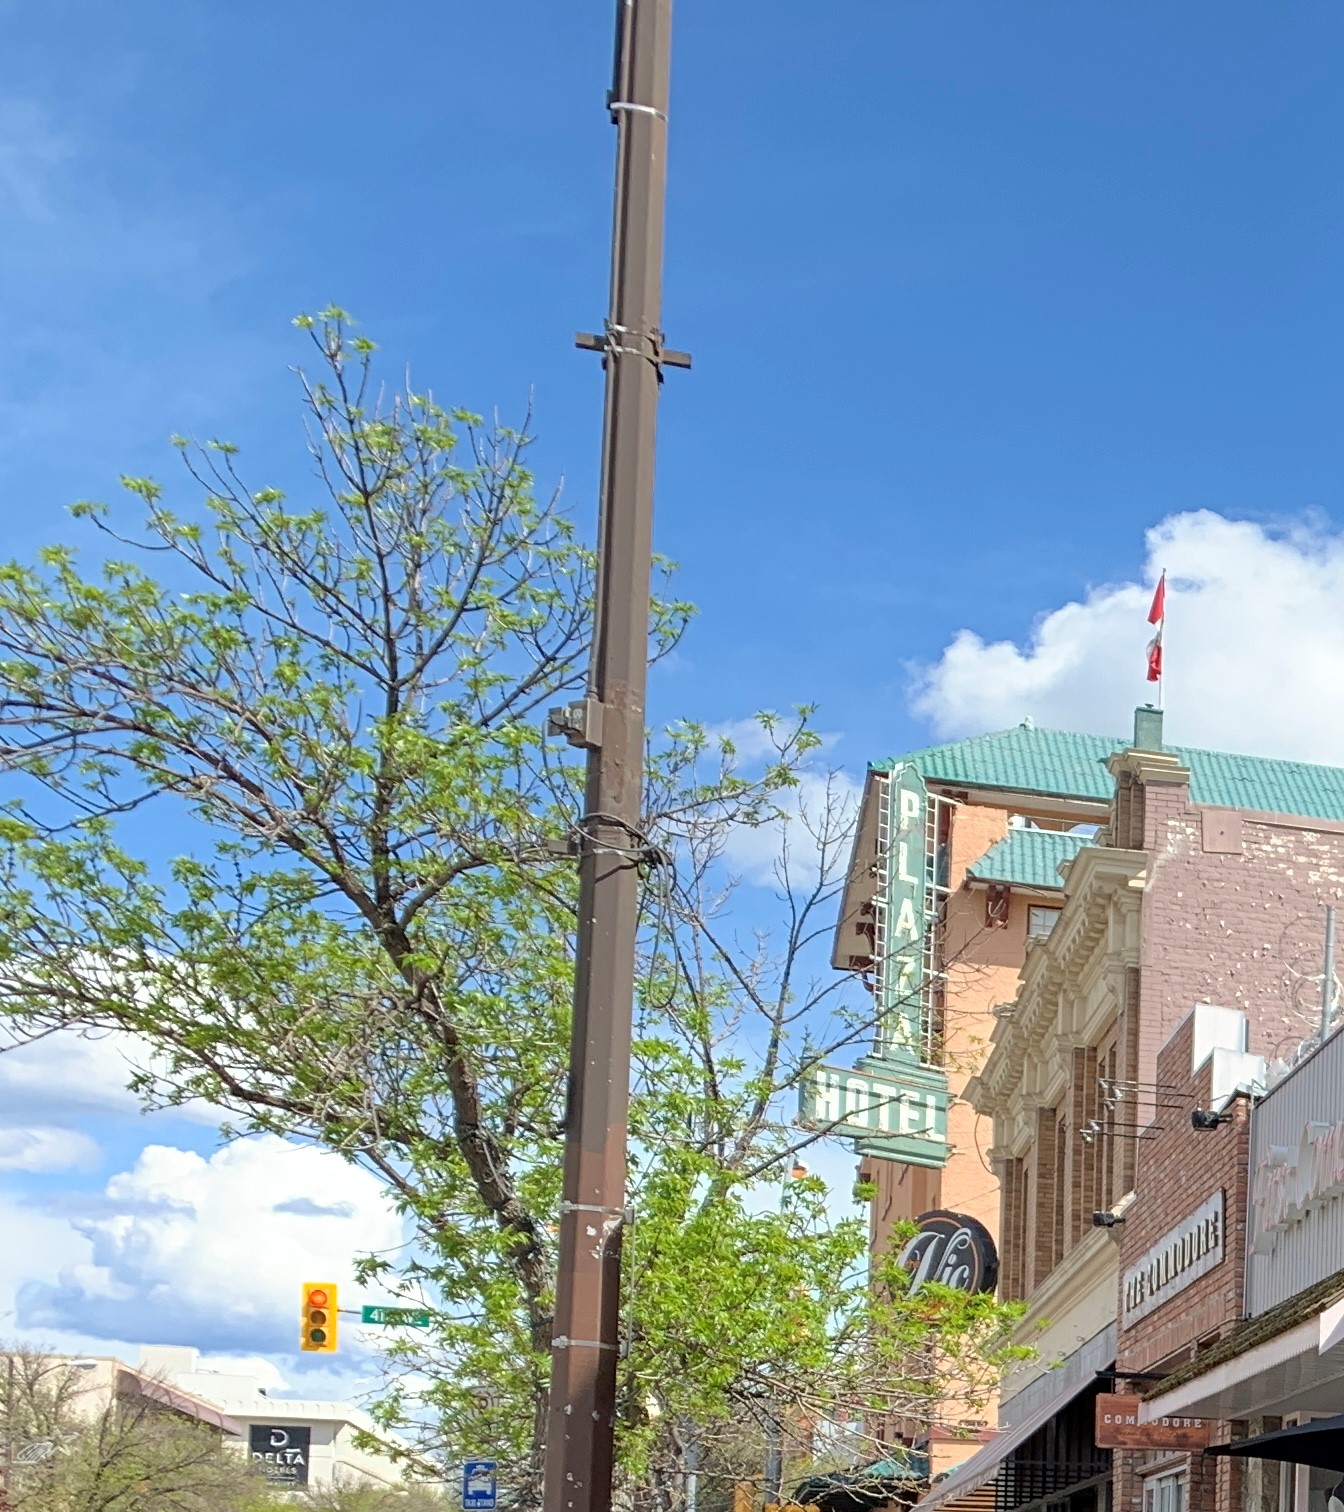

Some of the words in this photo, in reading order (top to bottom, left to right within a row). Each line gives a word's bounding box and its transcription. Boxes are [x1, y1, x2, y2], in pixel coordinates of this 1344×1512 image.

[889, 788, 920, 1056] PLAZA
[815, 1070, 947, 1143] HOTEL
[894, 1227, 972, 1301] Vic
[1104, 1414, 1202, 1428] COMODORE
[252, 1451, 305, 1465] DELTA
[261, 1466, 298, 1475] OTELS
